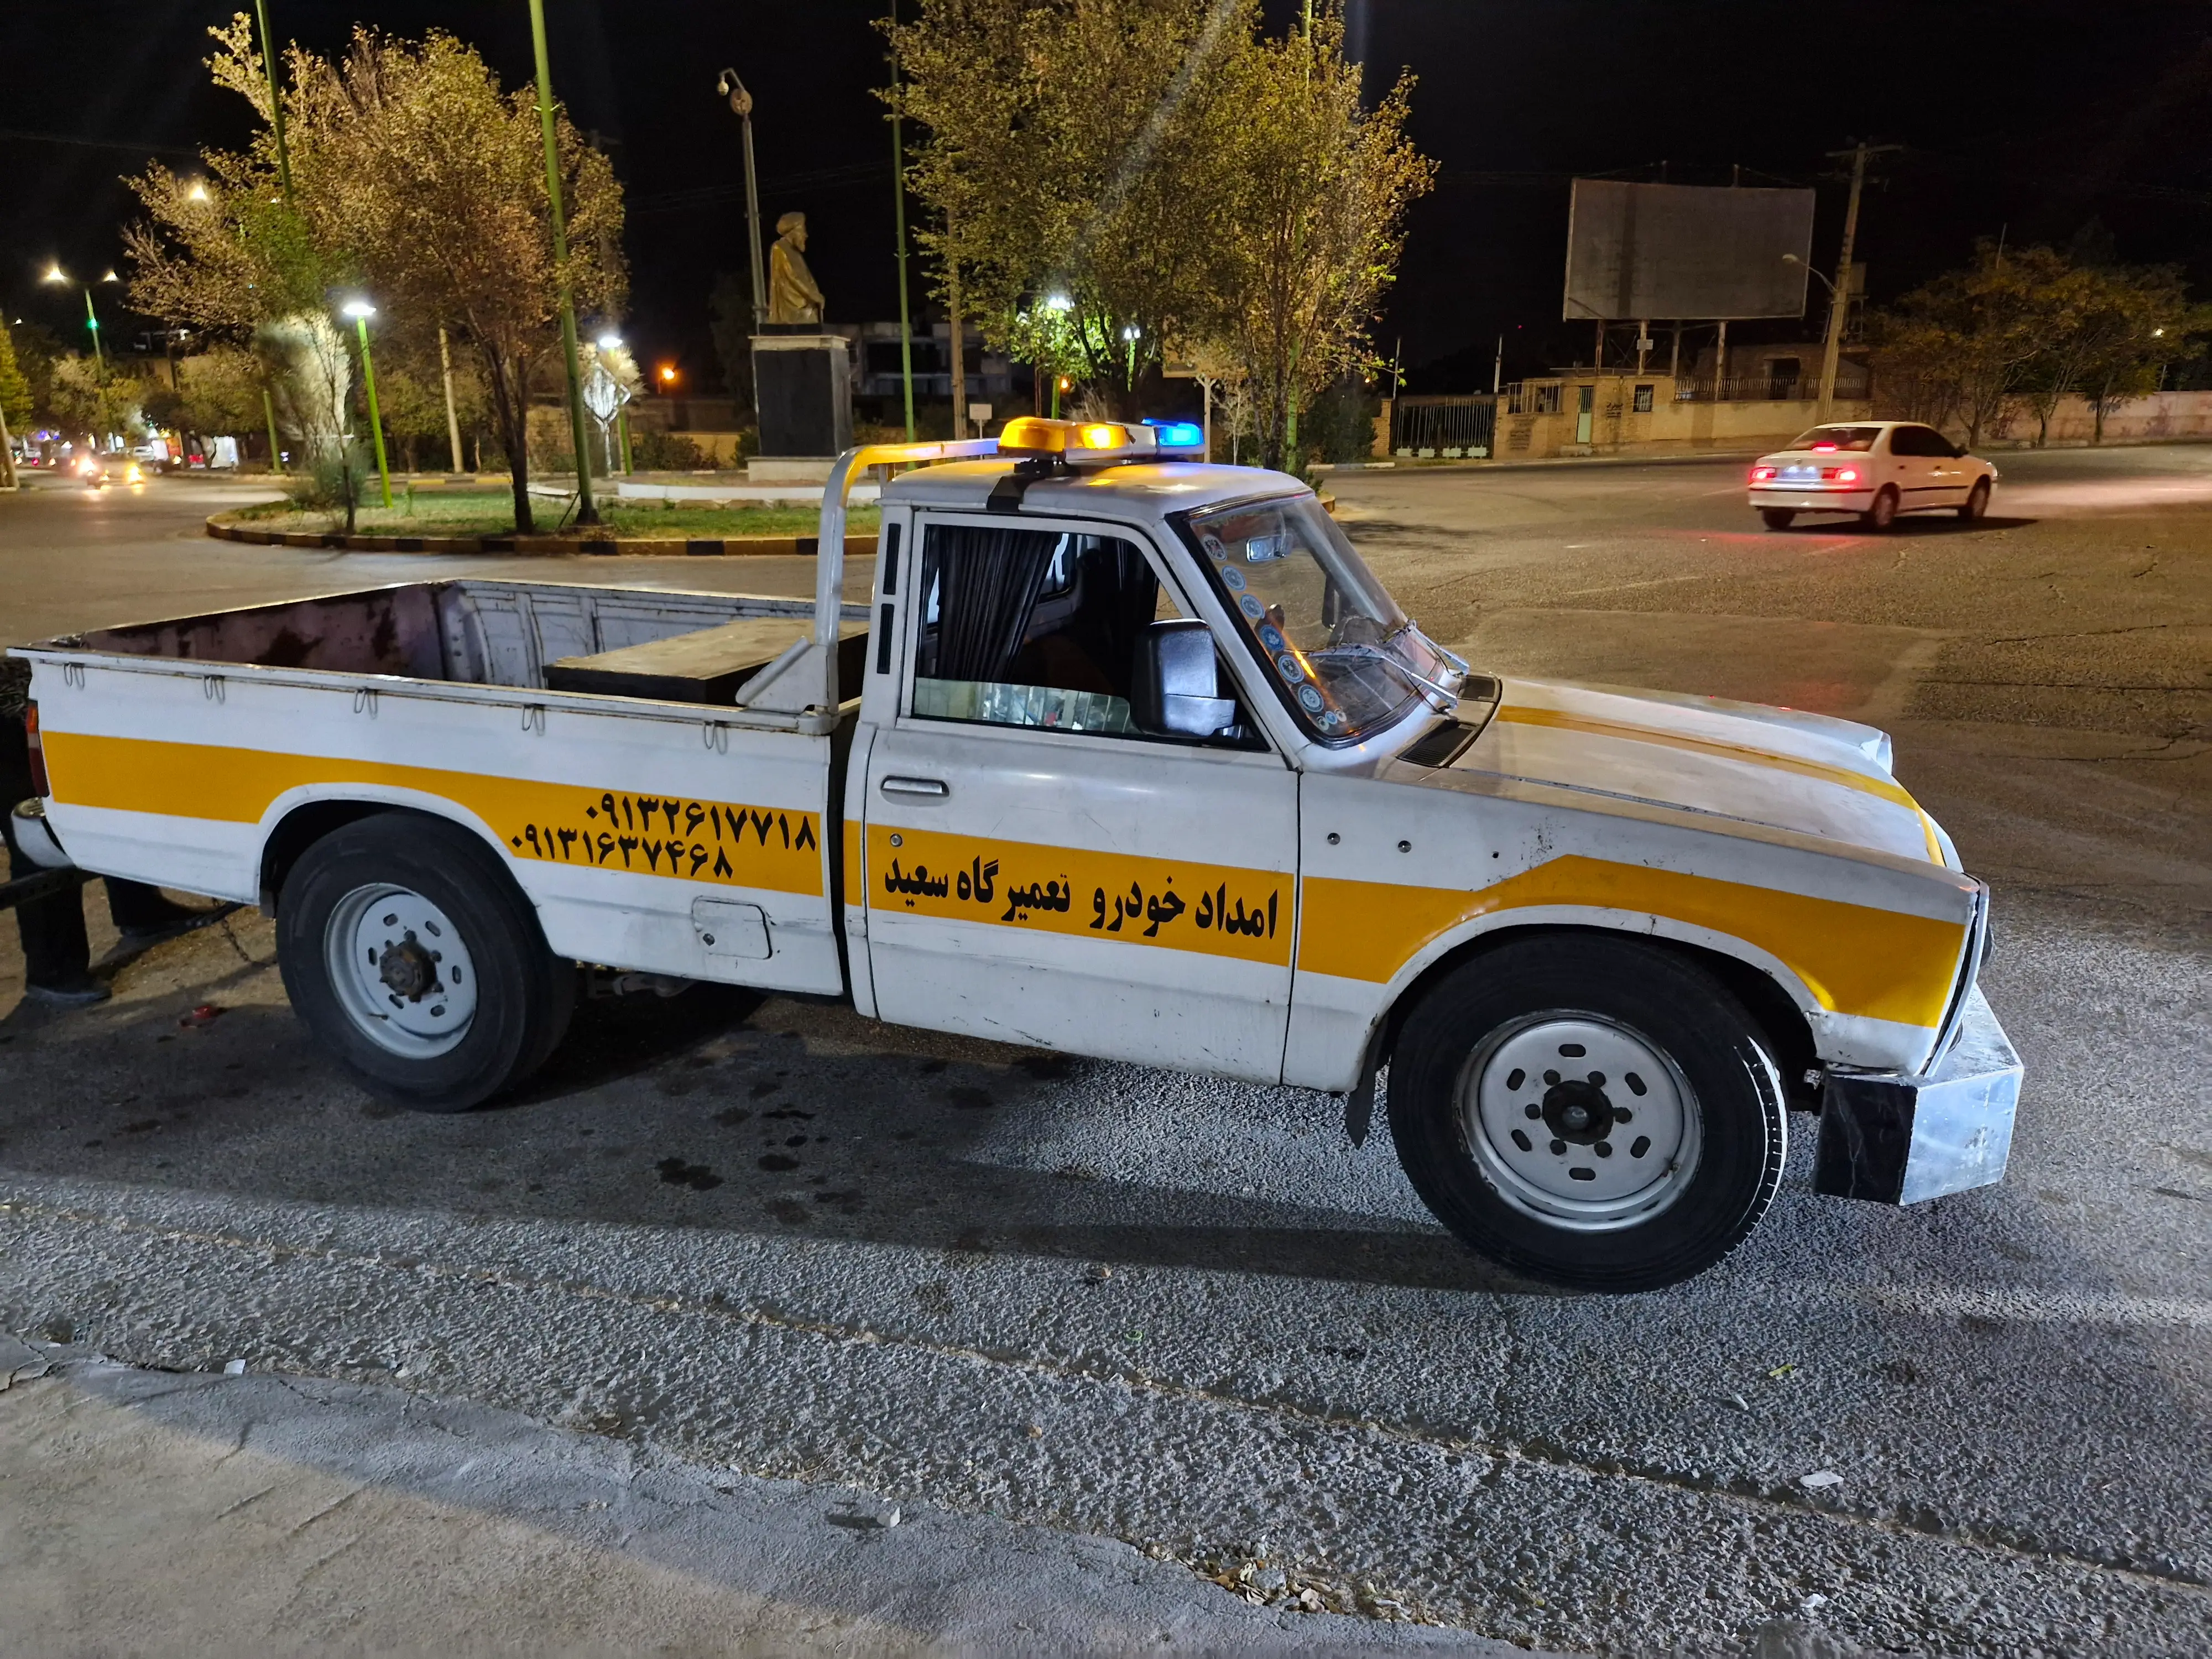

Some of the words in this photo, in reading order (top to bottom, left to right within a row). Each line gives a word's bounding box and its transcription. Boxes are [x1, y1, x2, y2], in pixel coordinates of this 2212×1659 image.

[511, 823, 734, 879] ۰۹۱۳۱۶۳۷۴۶۸
[586, 792, 816, 852] ۰۹۱۳۲۶۱۷۷۱۸
[884, 857, 949, 908] سعید
[1089, 875, 1186, 938] خودرو
[1194, 881, 1278, 940] امداد
